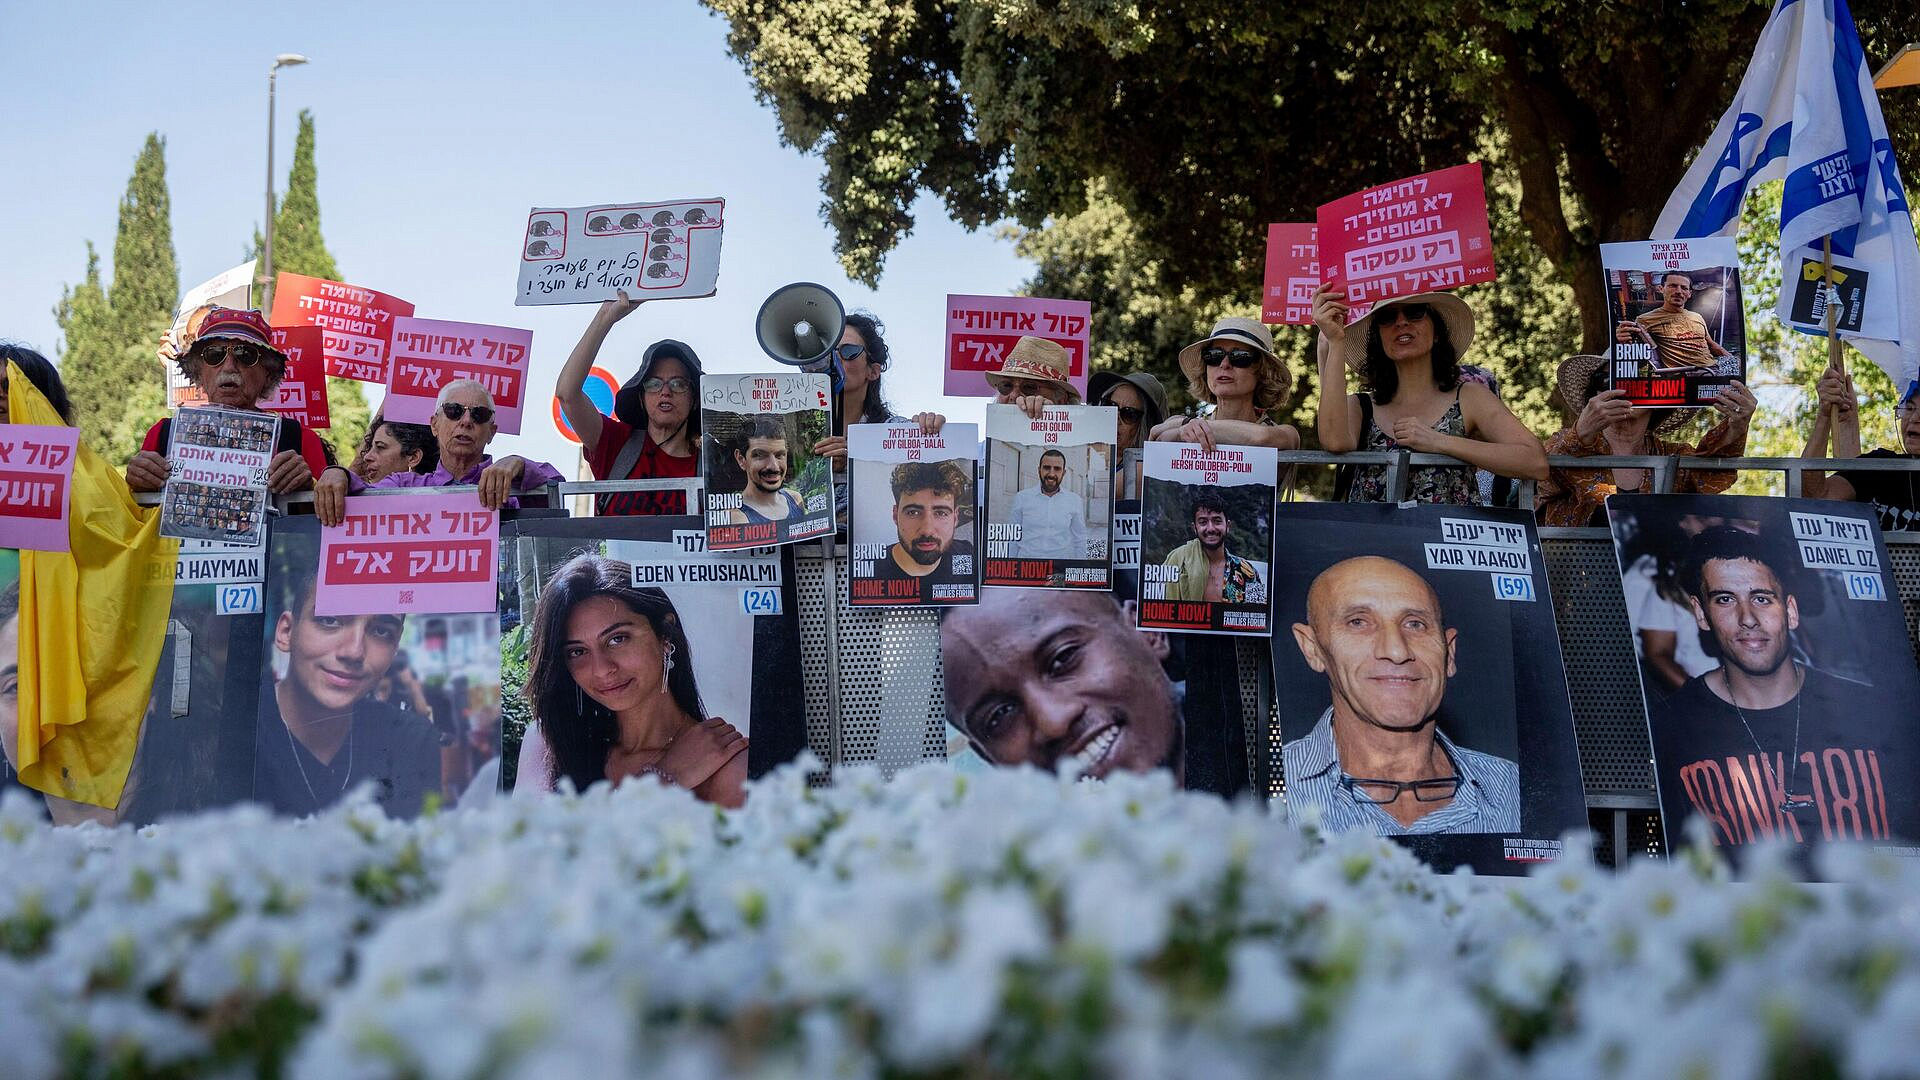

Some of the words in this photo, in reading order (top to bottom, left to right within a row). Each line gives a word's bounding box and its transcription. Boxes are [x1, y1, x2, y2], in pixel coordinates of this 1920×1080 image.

[1363, 178, 1428, 207] לחימה
[1424, 192, 1452, 213] לא
[1344, 200, 1418, 231] מחזירה
[1422, 241, 1454, 262] רק
[1672, 242, 1688, 251] אביב
[597, 259, 616, 271] יום
[622, 252, 640, 269] כל
[1351, 246, 1416, 273] עסקה
[1652, 252, 1668, 261] AVIV
[1670, 252, 1689, 260] ATZILI
[1664, 260, 1679, 269] (49)
[543, 258, 588, 275] שעובר
[574, 272, 592, 290] לא
[598, 271, 633, 288] חטוף
[1404, 265, 1465, 291] תציל
[320, 283, 375, 304] לחימה
[1348, 277, 1398, 302] חיים
[299, 296, 362, 317] מחזירה
[365, 307, 390, 322] לא
[953, 310, 1035, 330] אחיותיי
[1043, 312, 1085, 336] קול
[324, 336, 349, 352] עס
[355, 342, 379, 357] רק
[398, 332, 474, 357] אחיותיי
[482, 338, 525, 365] קול
[959, 340, 1004, 362] אלי
[1616, 343, 1651, 360] BRING
[335, 360, 380, 381] תציל
[400, 364, 441, 388] אלי
[1616, 361, 1638, 378] HIM
[172, 375, 190, 387] HIM
[754, 379, 763, 388] לוי
[765, 378, 776, 388] אור
[1616, 380, 1648, 397] HOME
[1652, 378, 1685, 397] NOW!
[173, 388, 199, 401] HOME
[280, 388, 301, 404] רק
[752, 390, 762, 399] OR
[763, 390, 778, 399] LEVY
[760, 400, 772, 411] (33)
[1056, 411, 1069, 421] אורן
[1031, 422, 1048, 431] OREN
[1049, 422, 1072, 432] GOLDIN
[883, 440, 896, 449] GUY
[898, 439, 946, 449] GILBOA-DALAL
[1045, 432, 1057, 443] (33)
[22, 441, 70, 469] קול
[179, 447, 215, 461] אותם
[220, 451, 263, 466] תוציאו
[907, 449, 920, 460] (22)
[1228, 451, 1243, 461] הרש
[1171, 460, 1193, 470] HERSH
[1195, 460, 1252, 473] GOLDBERG-POLIN
[1204, 472, 1218, 483] (23)
[708, 493, 743, 510] BRING
[441, 511, 492, 536] קול
[709, 511, 731, 526] HIM
[1797, 518, 1822, 536] עוז
[710, 527, 741, 543] HOME
[744, 522, 777, 540] NOW!
[987, 523, 1022, 541] BRING
[1445, 522, 1484, 541] יעקב
[1489, 526, 1522, 543] יאיר
[1824, 518, 1868, 540] דניאל
[854, 543, 887, 560] BRING
[987, 542, 1009, 558] HIM
[1429, 548, 1464, 565] YAIR
[1467, 550, 1526, 569] YAAKOV
[1804, 546, 1855, 565] DANIEL
[1857, 549, 1877, 567] OZ
[190, 559, 258, 579] HAYMAN
[336, 550, 393, 574] אלי
[409, 549, 482, 577] זועק
[853, 561, 874, 577] HIM
[986, 561, 1017, 577] HOME
[1021, 561, 1053, 579] NOW!
[636, 565, 674, 582] EDEN
[678, 564, 776, 582] YERUSHALMI
[1065, 573, 1087, 582] FAMILIES
[1144, 564, 1180, 583] BRING
[853, 580, 885, 597] HOME
[887, 576, 920, 596] NOW!
[932, 589, 956, 598] FAMILIES
[1144, 583, 1166, 600] HIM
[1497, 575, 1530, 599] (59)
[1850, 575, 1880, 599] (19)
[222, 586, 256, 613] (27)
[744, 590, 777, 613] (24)
[1142, 602, 1174, 620] HOME
[1177, 604, 1212, 622] NOW!
[1223, 617, 1246, 626] FAMILIES
[1248, 618, 1266, 628] FORUM
